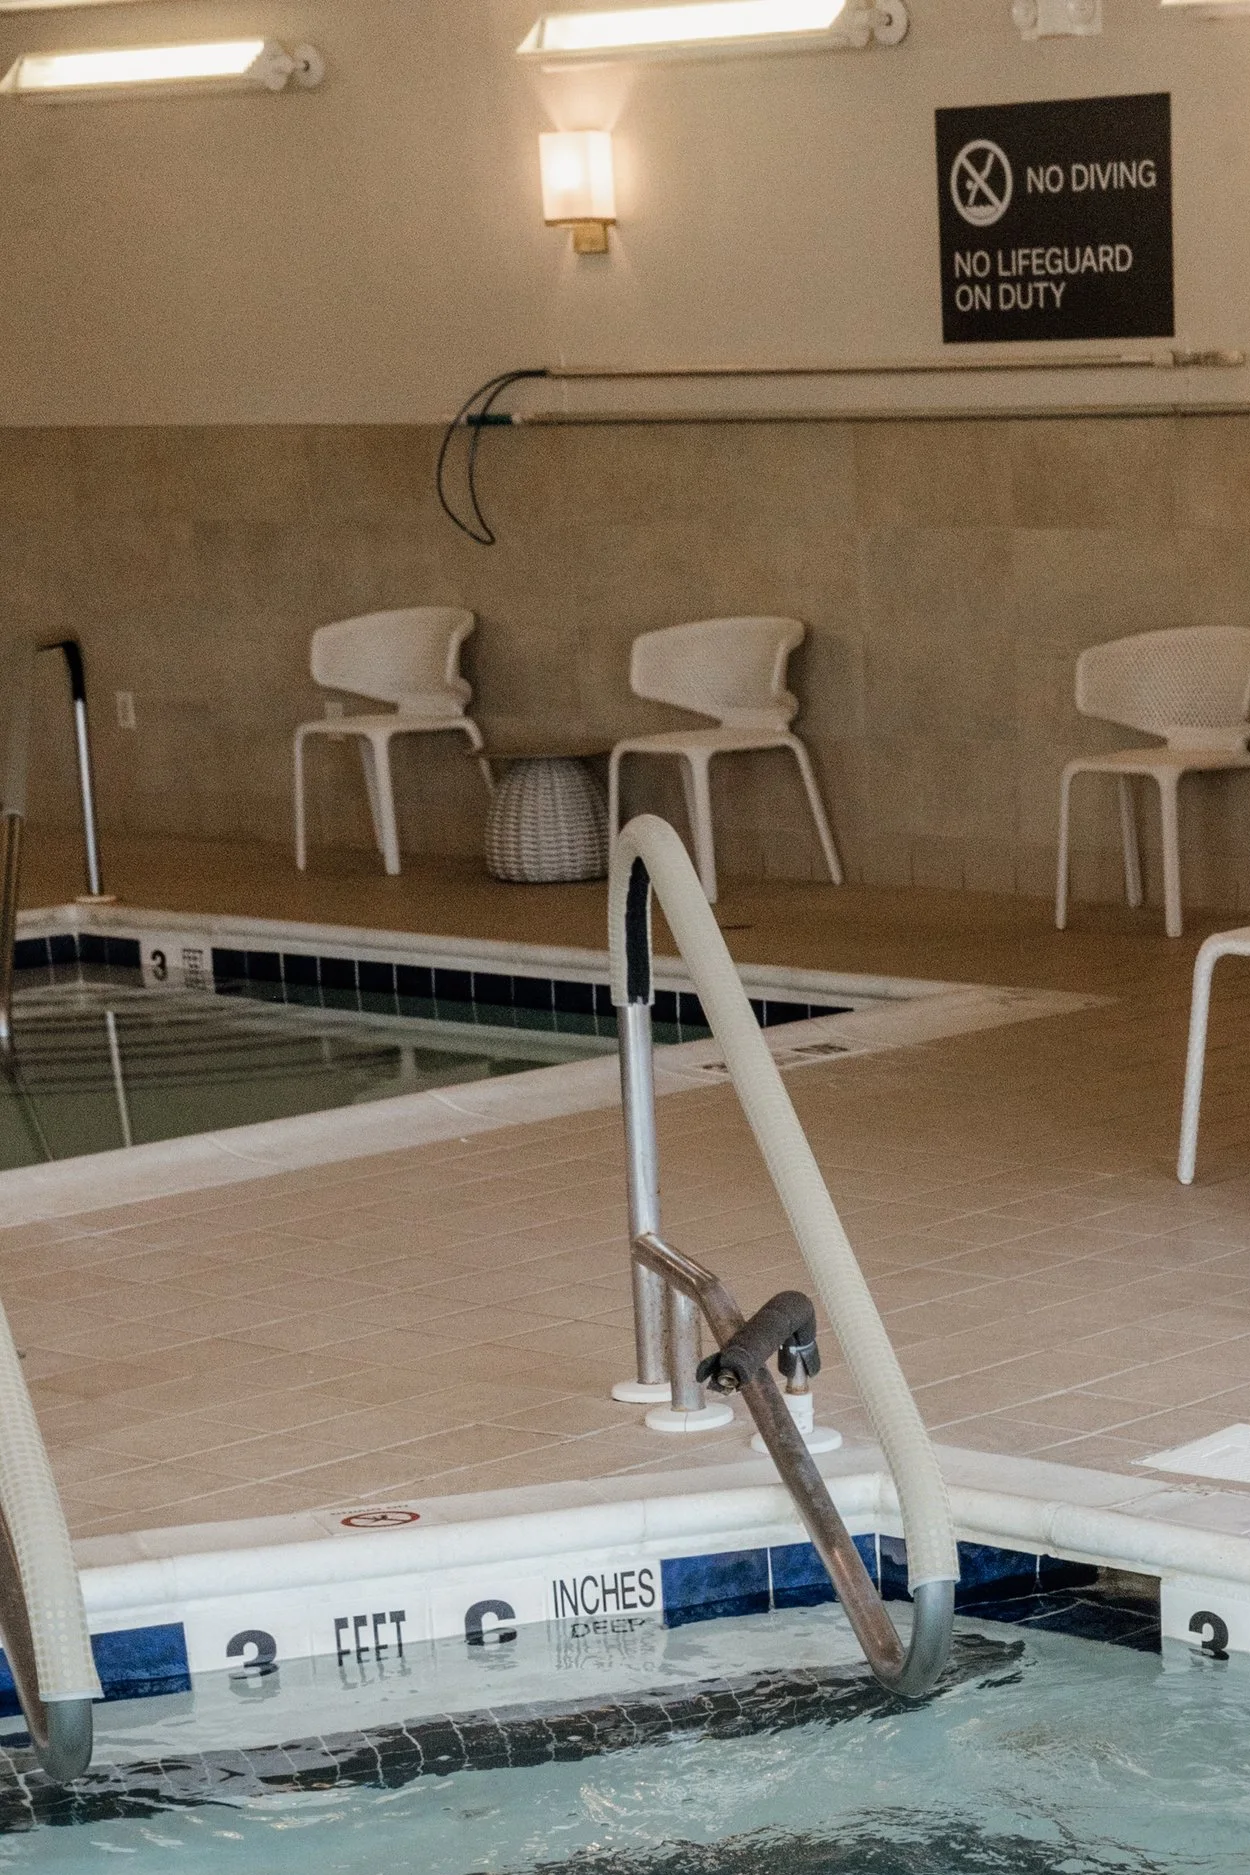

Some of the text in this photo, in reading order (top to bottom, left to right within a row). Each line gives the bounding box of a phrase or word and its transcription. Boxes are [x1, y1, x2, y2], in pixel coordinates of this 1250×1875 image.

[1026, 159, 1157, 194] NO DIVING
[954, 244, 1133, 278] NO LIFEGUARD
[955, 281, 1066, 312] ON DUTY
[553, 1568, 655, 1618] INCHES
